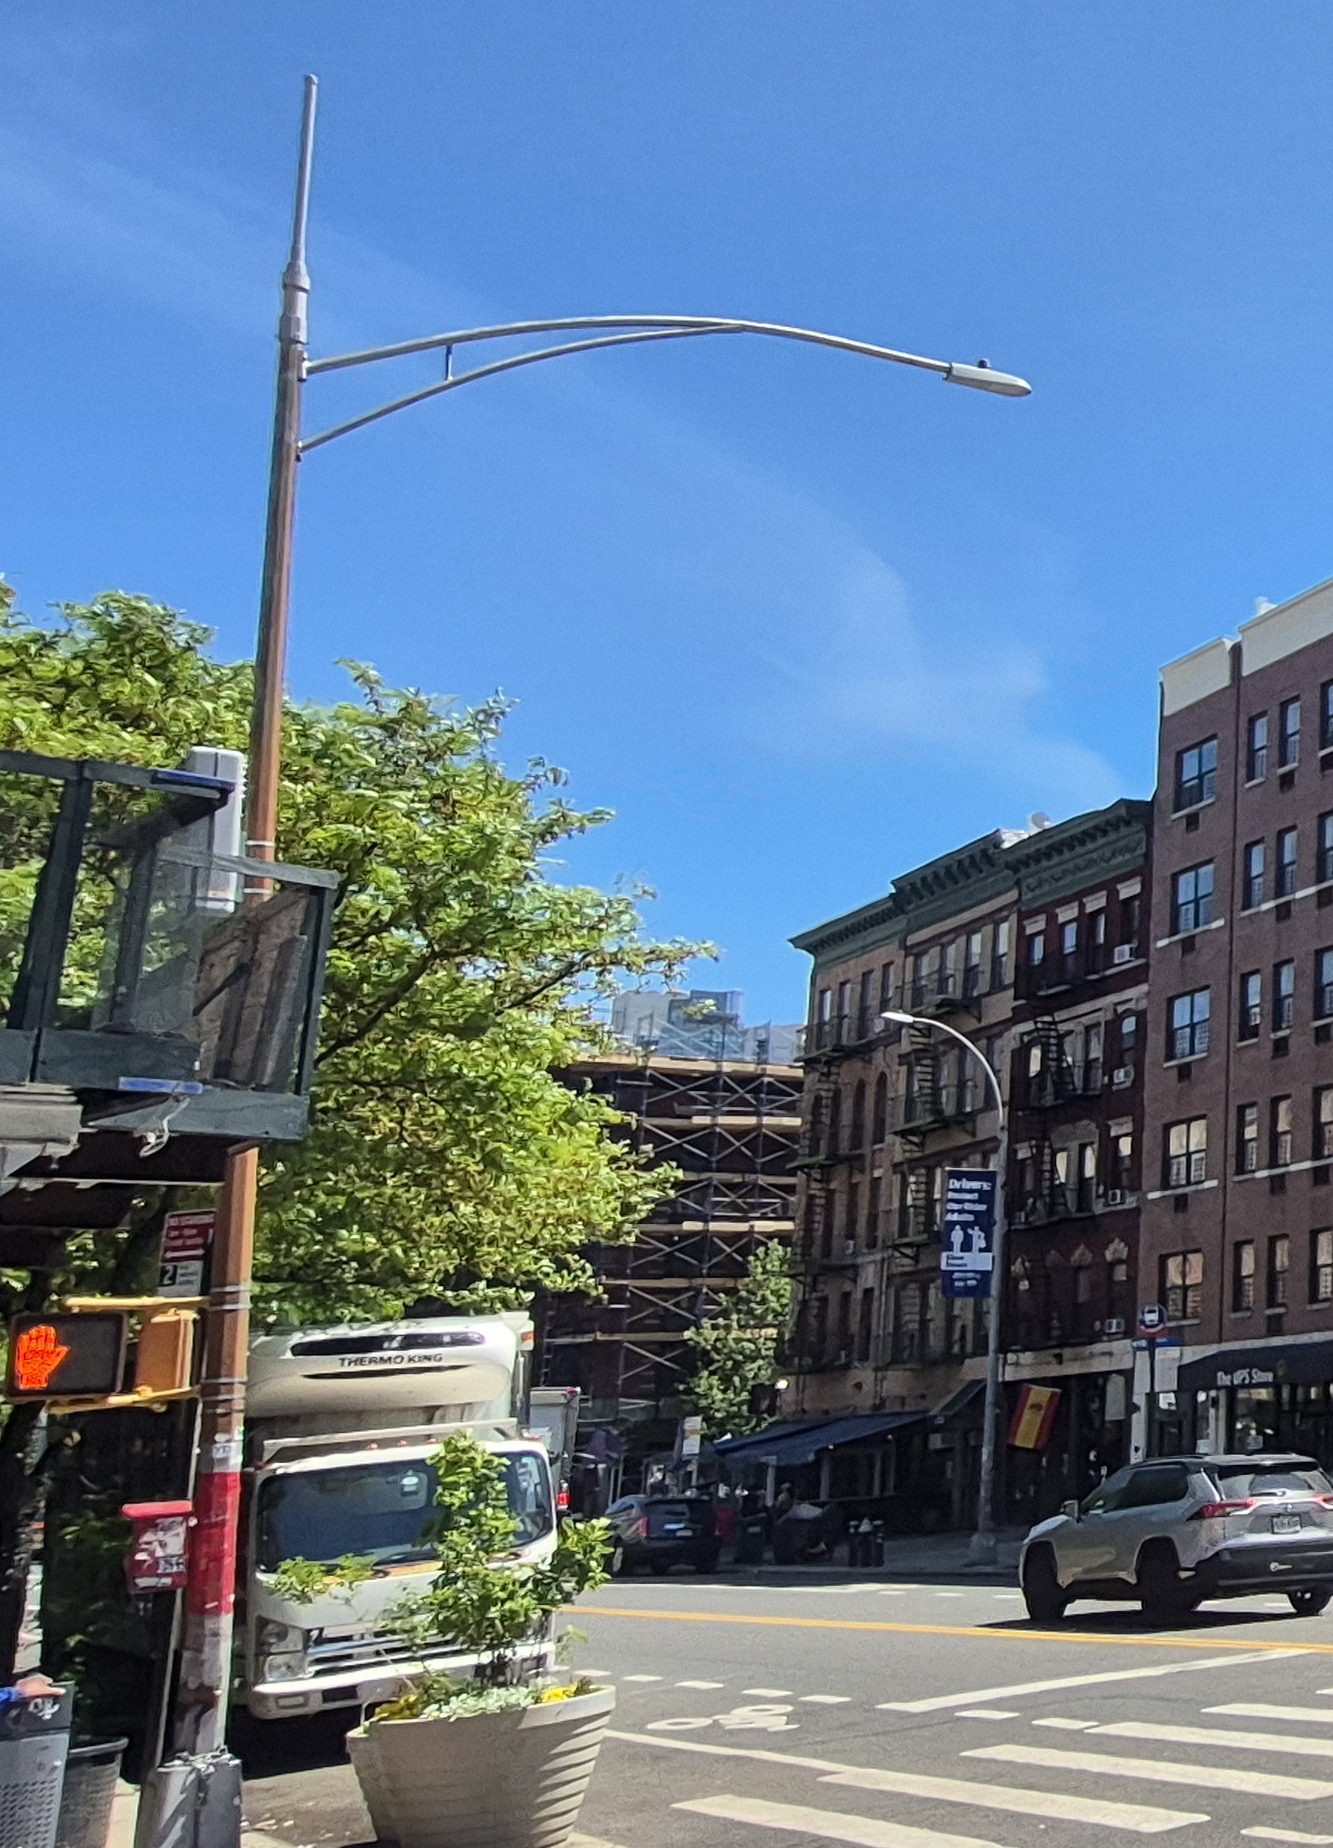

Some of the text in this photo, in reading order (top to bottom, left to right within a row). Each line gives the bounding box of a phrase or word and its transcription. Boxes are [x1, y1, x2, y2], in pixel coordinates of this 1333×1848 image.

[338, 1353, 443, 1367] THERMO KING
[1233, 1368, 1250, 1385] UPS
[1251, 1367, 1274, 1383] Store
